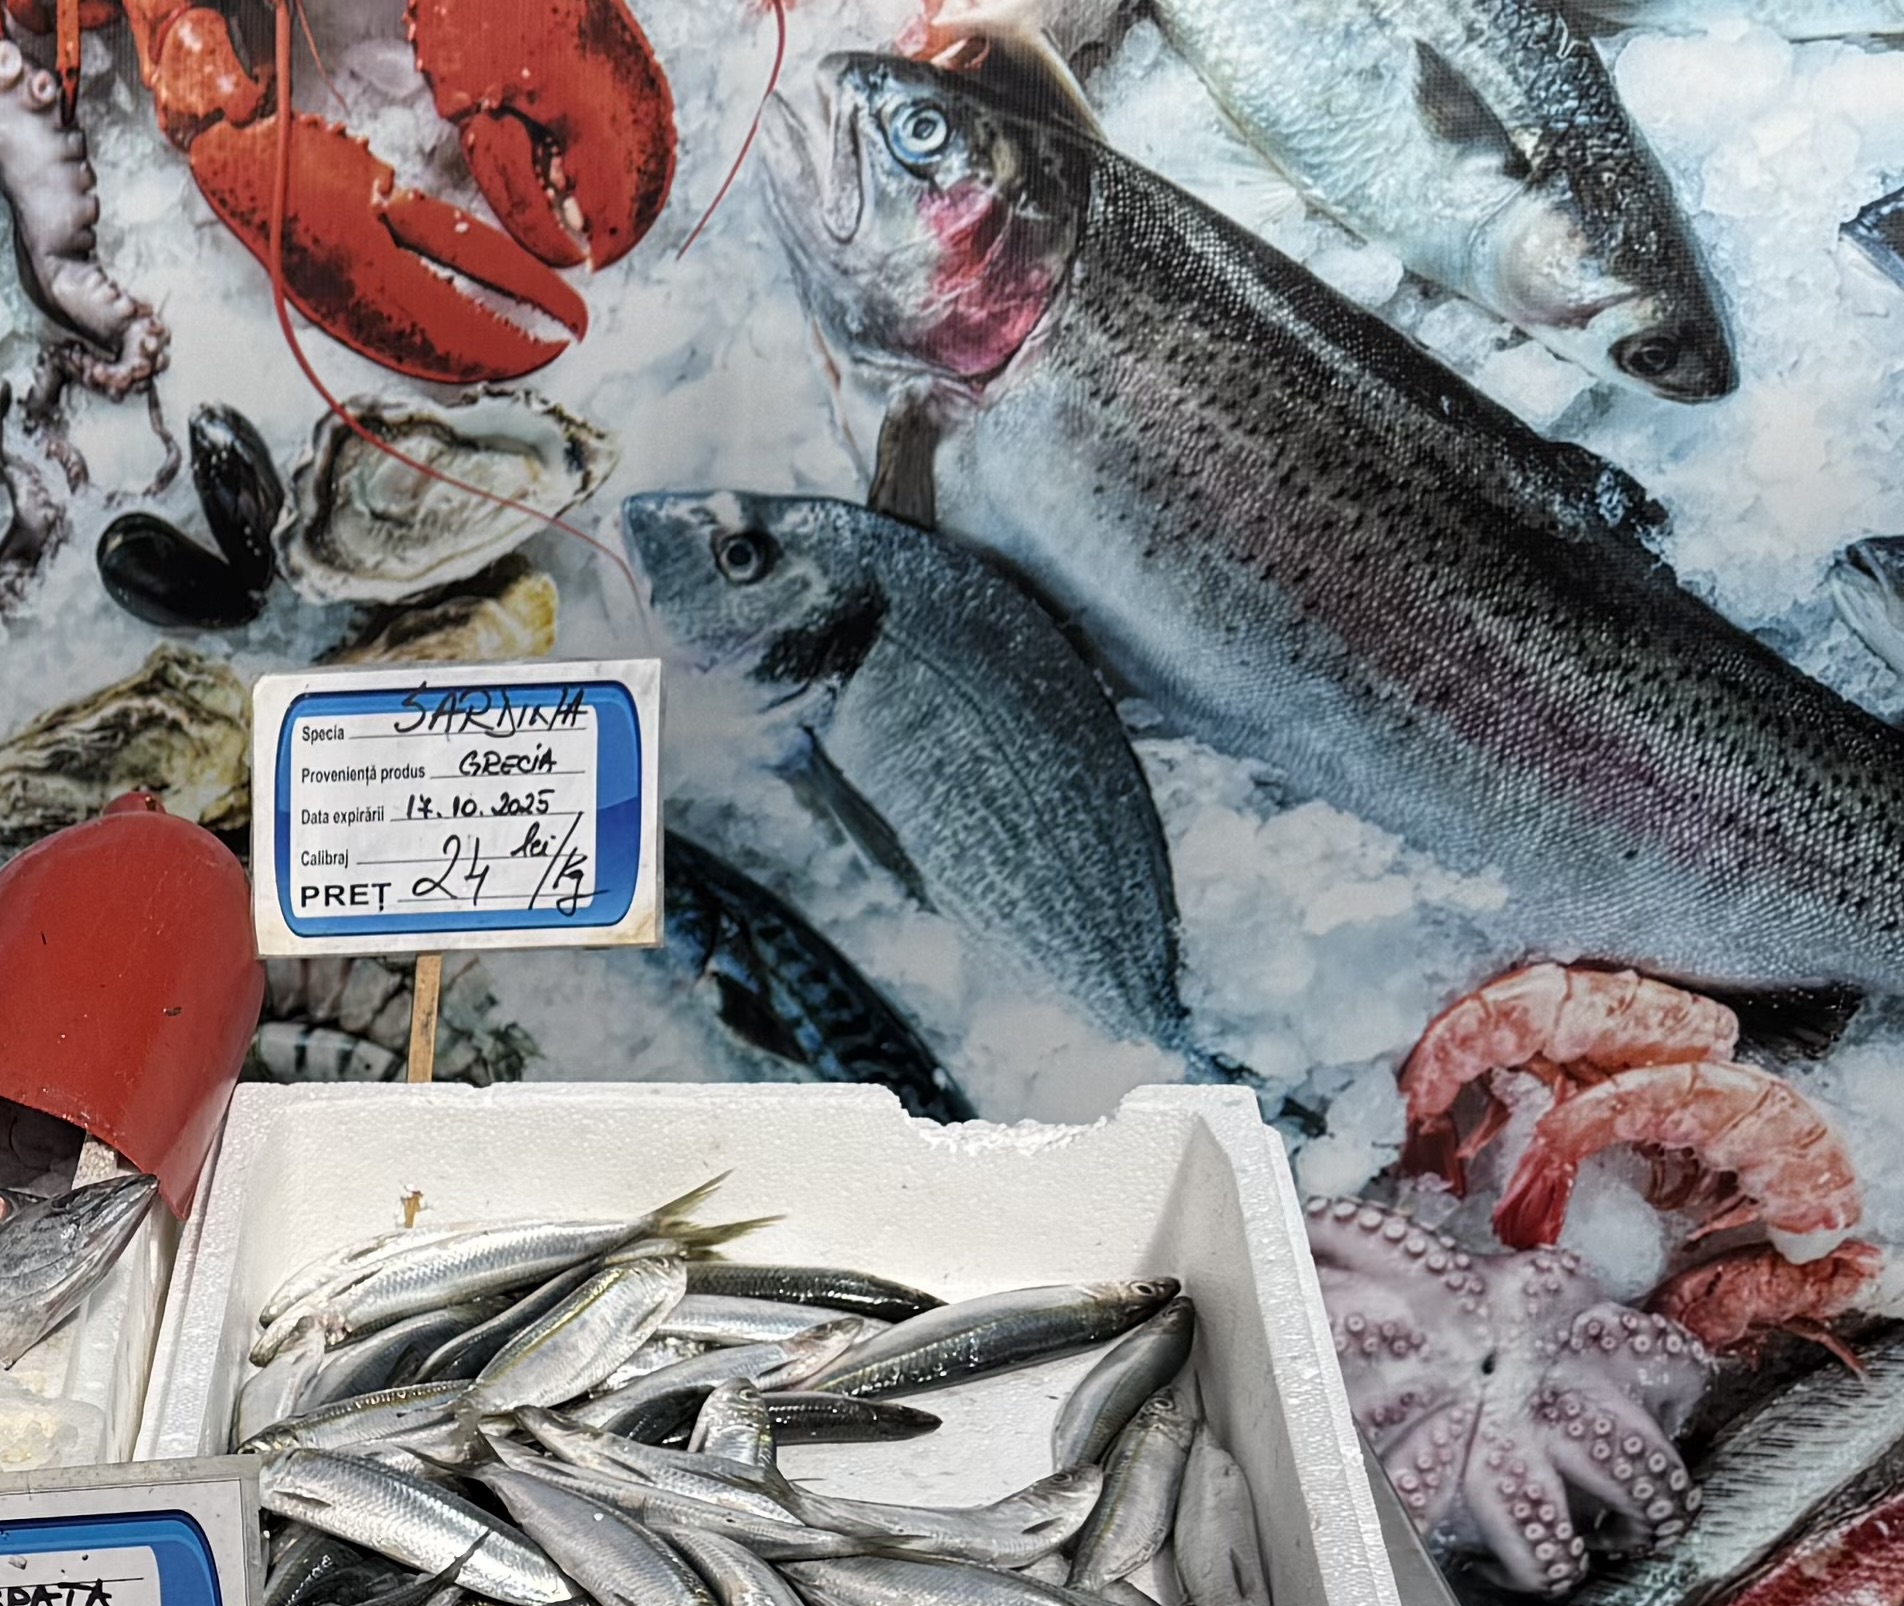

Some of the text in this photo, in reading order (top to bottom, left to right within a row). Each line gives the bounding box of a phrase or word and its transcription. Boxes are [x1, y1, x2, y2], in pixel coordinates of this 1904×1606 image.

[302, 727, 344, 743] Specia
[301, 767, 376, 786] Proveniență
[382, 765, 425, 782] produs
[301, 807, 384, 826] Data expirării
[301, 851, 348, 869] Calibraj
[301, 834, 490, 912] PREȚ 24
